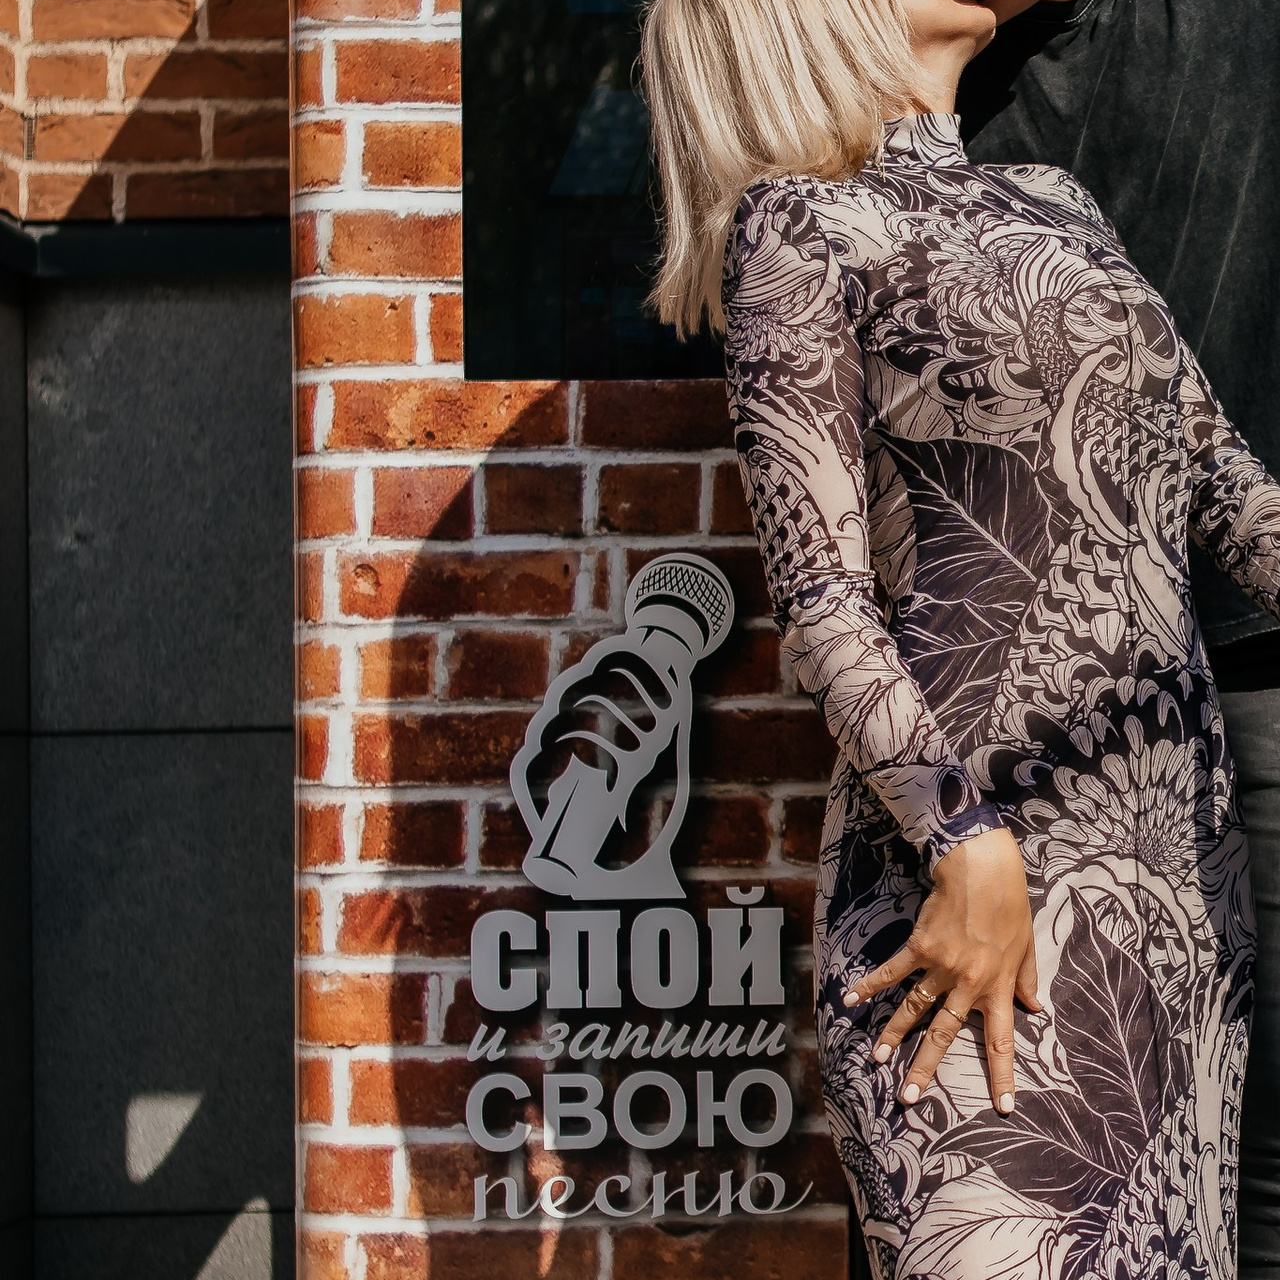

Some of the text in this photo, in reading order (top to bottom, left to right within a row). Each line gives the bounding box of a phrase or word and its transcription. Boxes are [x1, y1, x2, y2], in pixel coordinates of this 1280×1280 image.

[470, 886, 785, 1012] СПОЙ
[466, 1019, 787, 1062] и запиши
[465, 1068, 793, 1152] СВОЮ
[472, 1169, 814, 1223] песню
